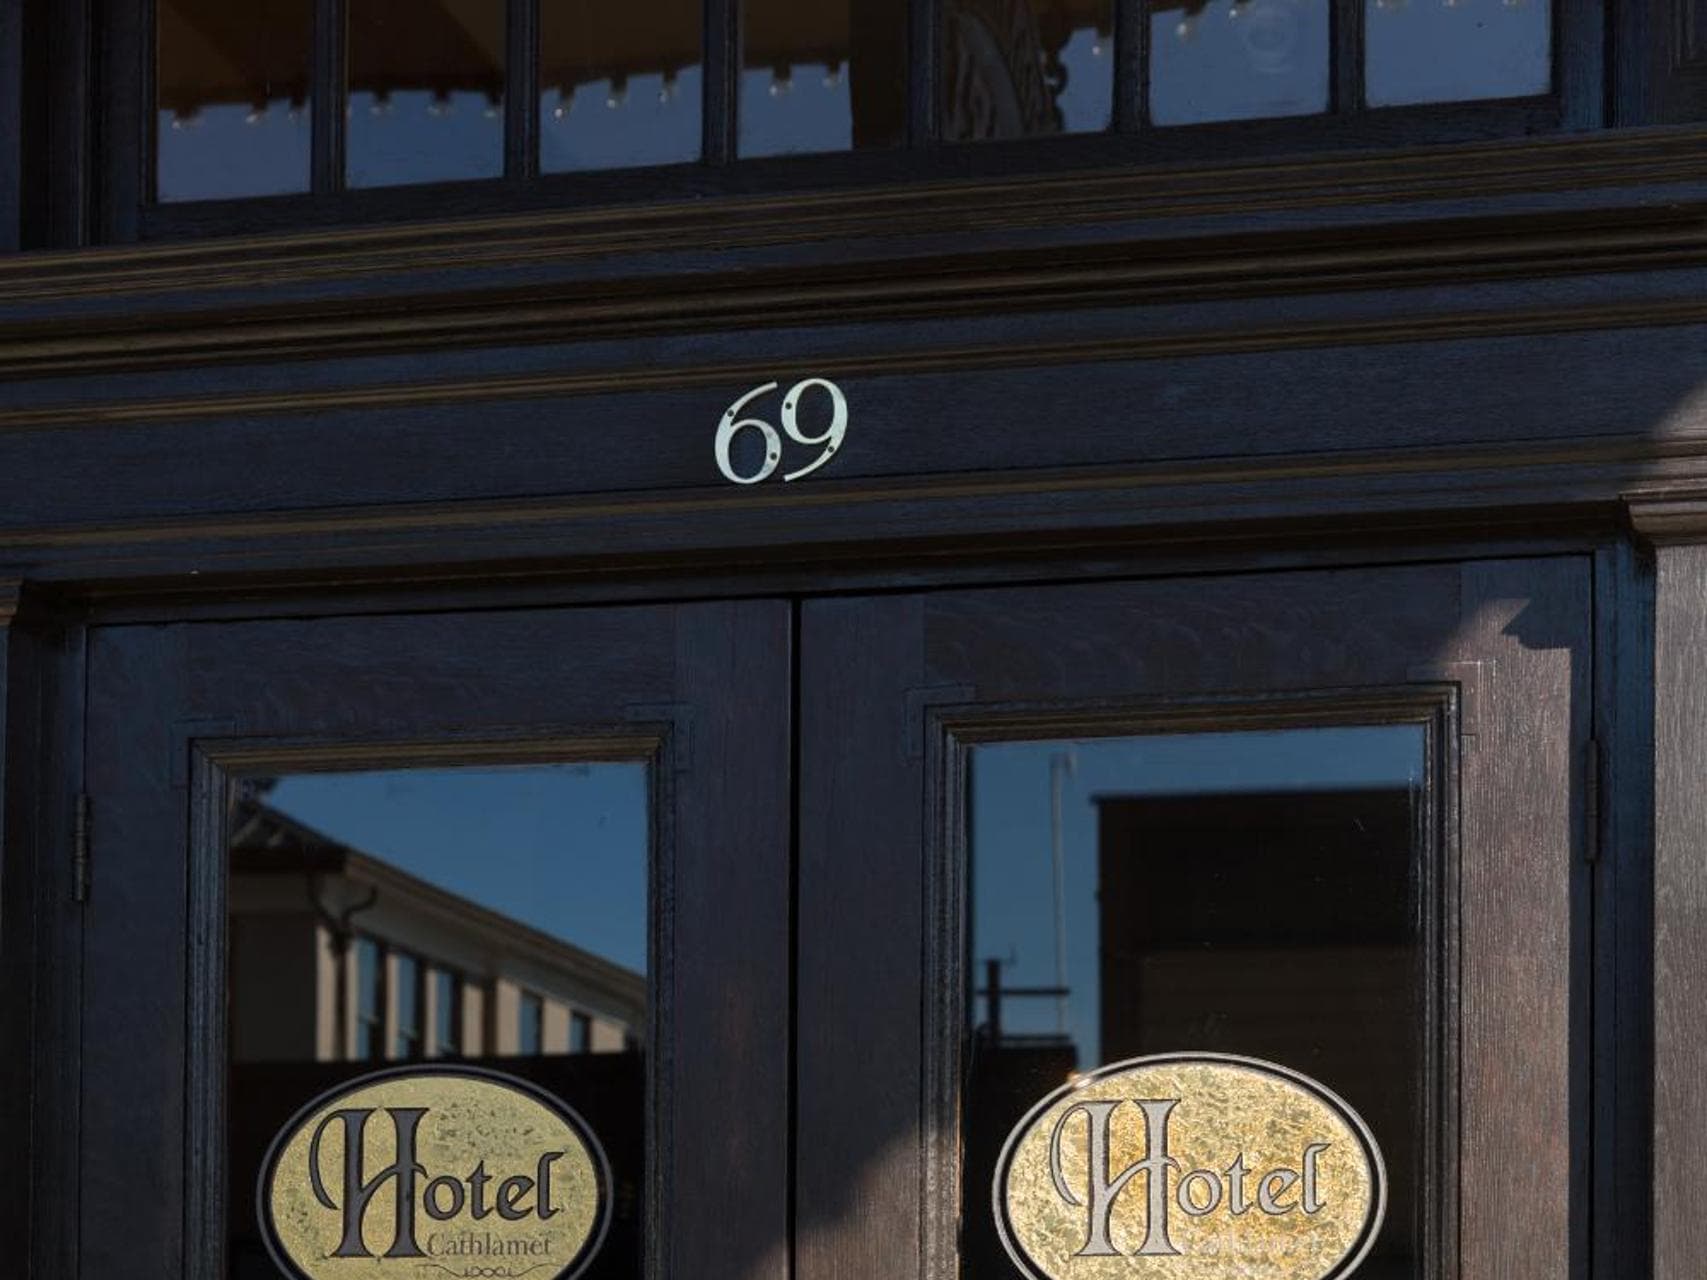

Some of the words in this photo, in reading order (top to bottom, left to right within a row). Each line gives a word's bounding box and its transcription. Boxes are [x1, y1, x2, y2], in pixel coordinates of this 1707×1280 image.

[715, 378, 848, 484] 69
[308, 1106, 567, 1258] Hotel
[1050, 1098, 1332, 1256] Hotel
[427, 1231, 551, 1256] Cathlamet
